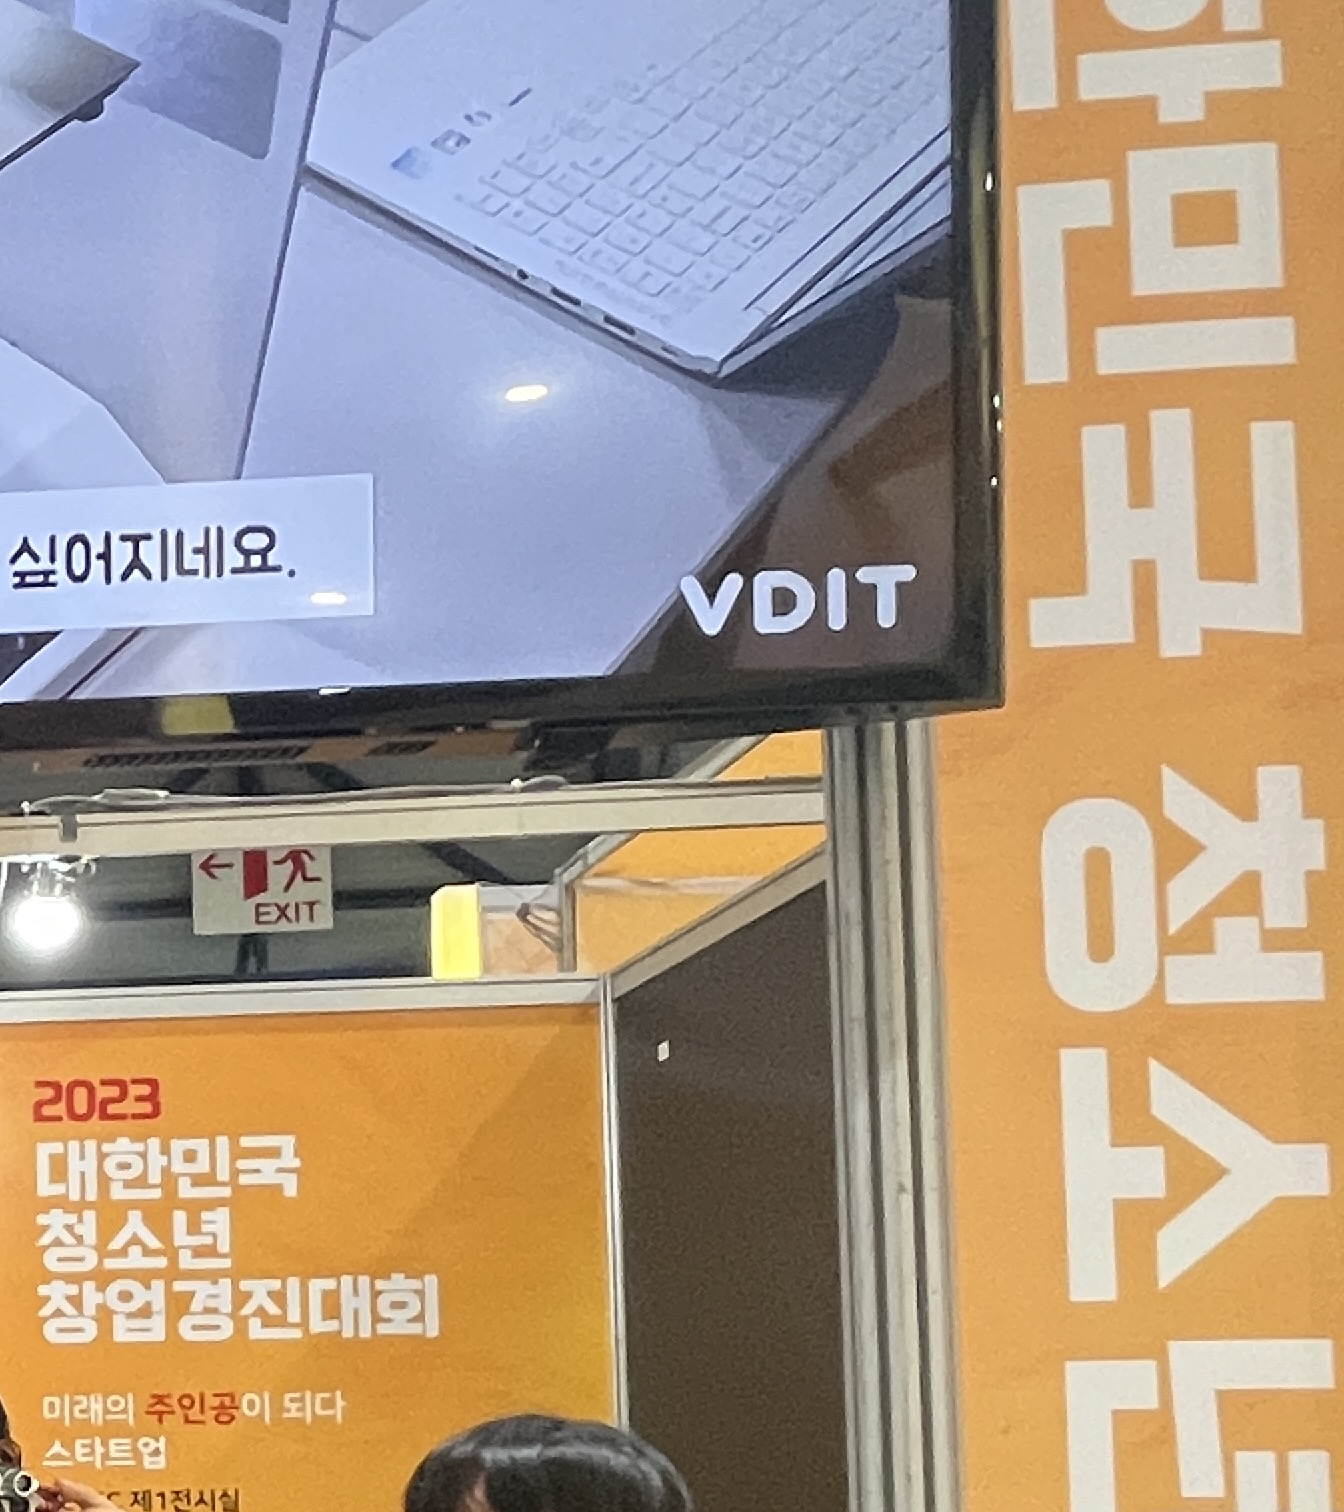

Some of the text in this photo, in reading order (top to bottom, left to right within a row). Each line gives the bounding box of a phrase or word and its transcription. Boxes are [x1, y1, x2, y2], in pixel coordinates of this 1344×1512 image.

[9, 523, 297, 589] 싶어지네요.
[680, 563, 917, 636] VDIT
[254, 900, 320, 926] EXIT
[33, 1077, 161, 1123] 2023
[36, 1134, 301, 1201] 대한민국
[35, 1207, 232, 1273] 청소년
[36, 1273, 440, 1344] 창업경진대회
[42, 1390, 345, 1426] 미래의 주인공이 되다
[42, 1436, 167, 1470] 스타트업
[129, 1488, 240, 1512] 제1전시실
